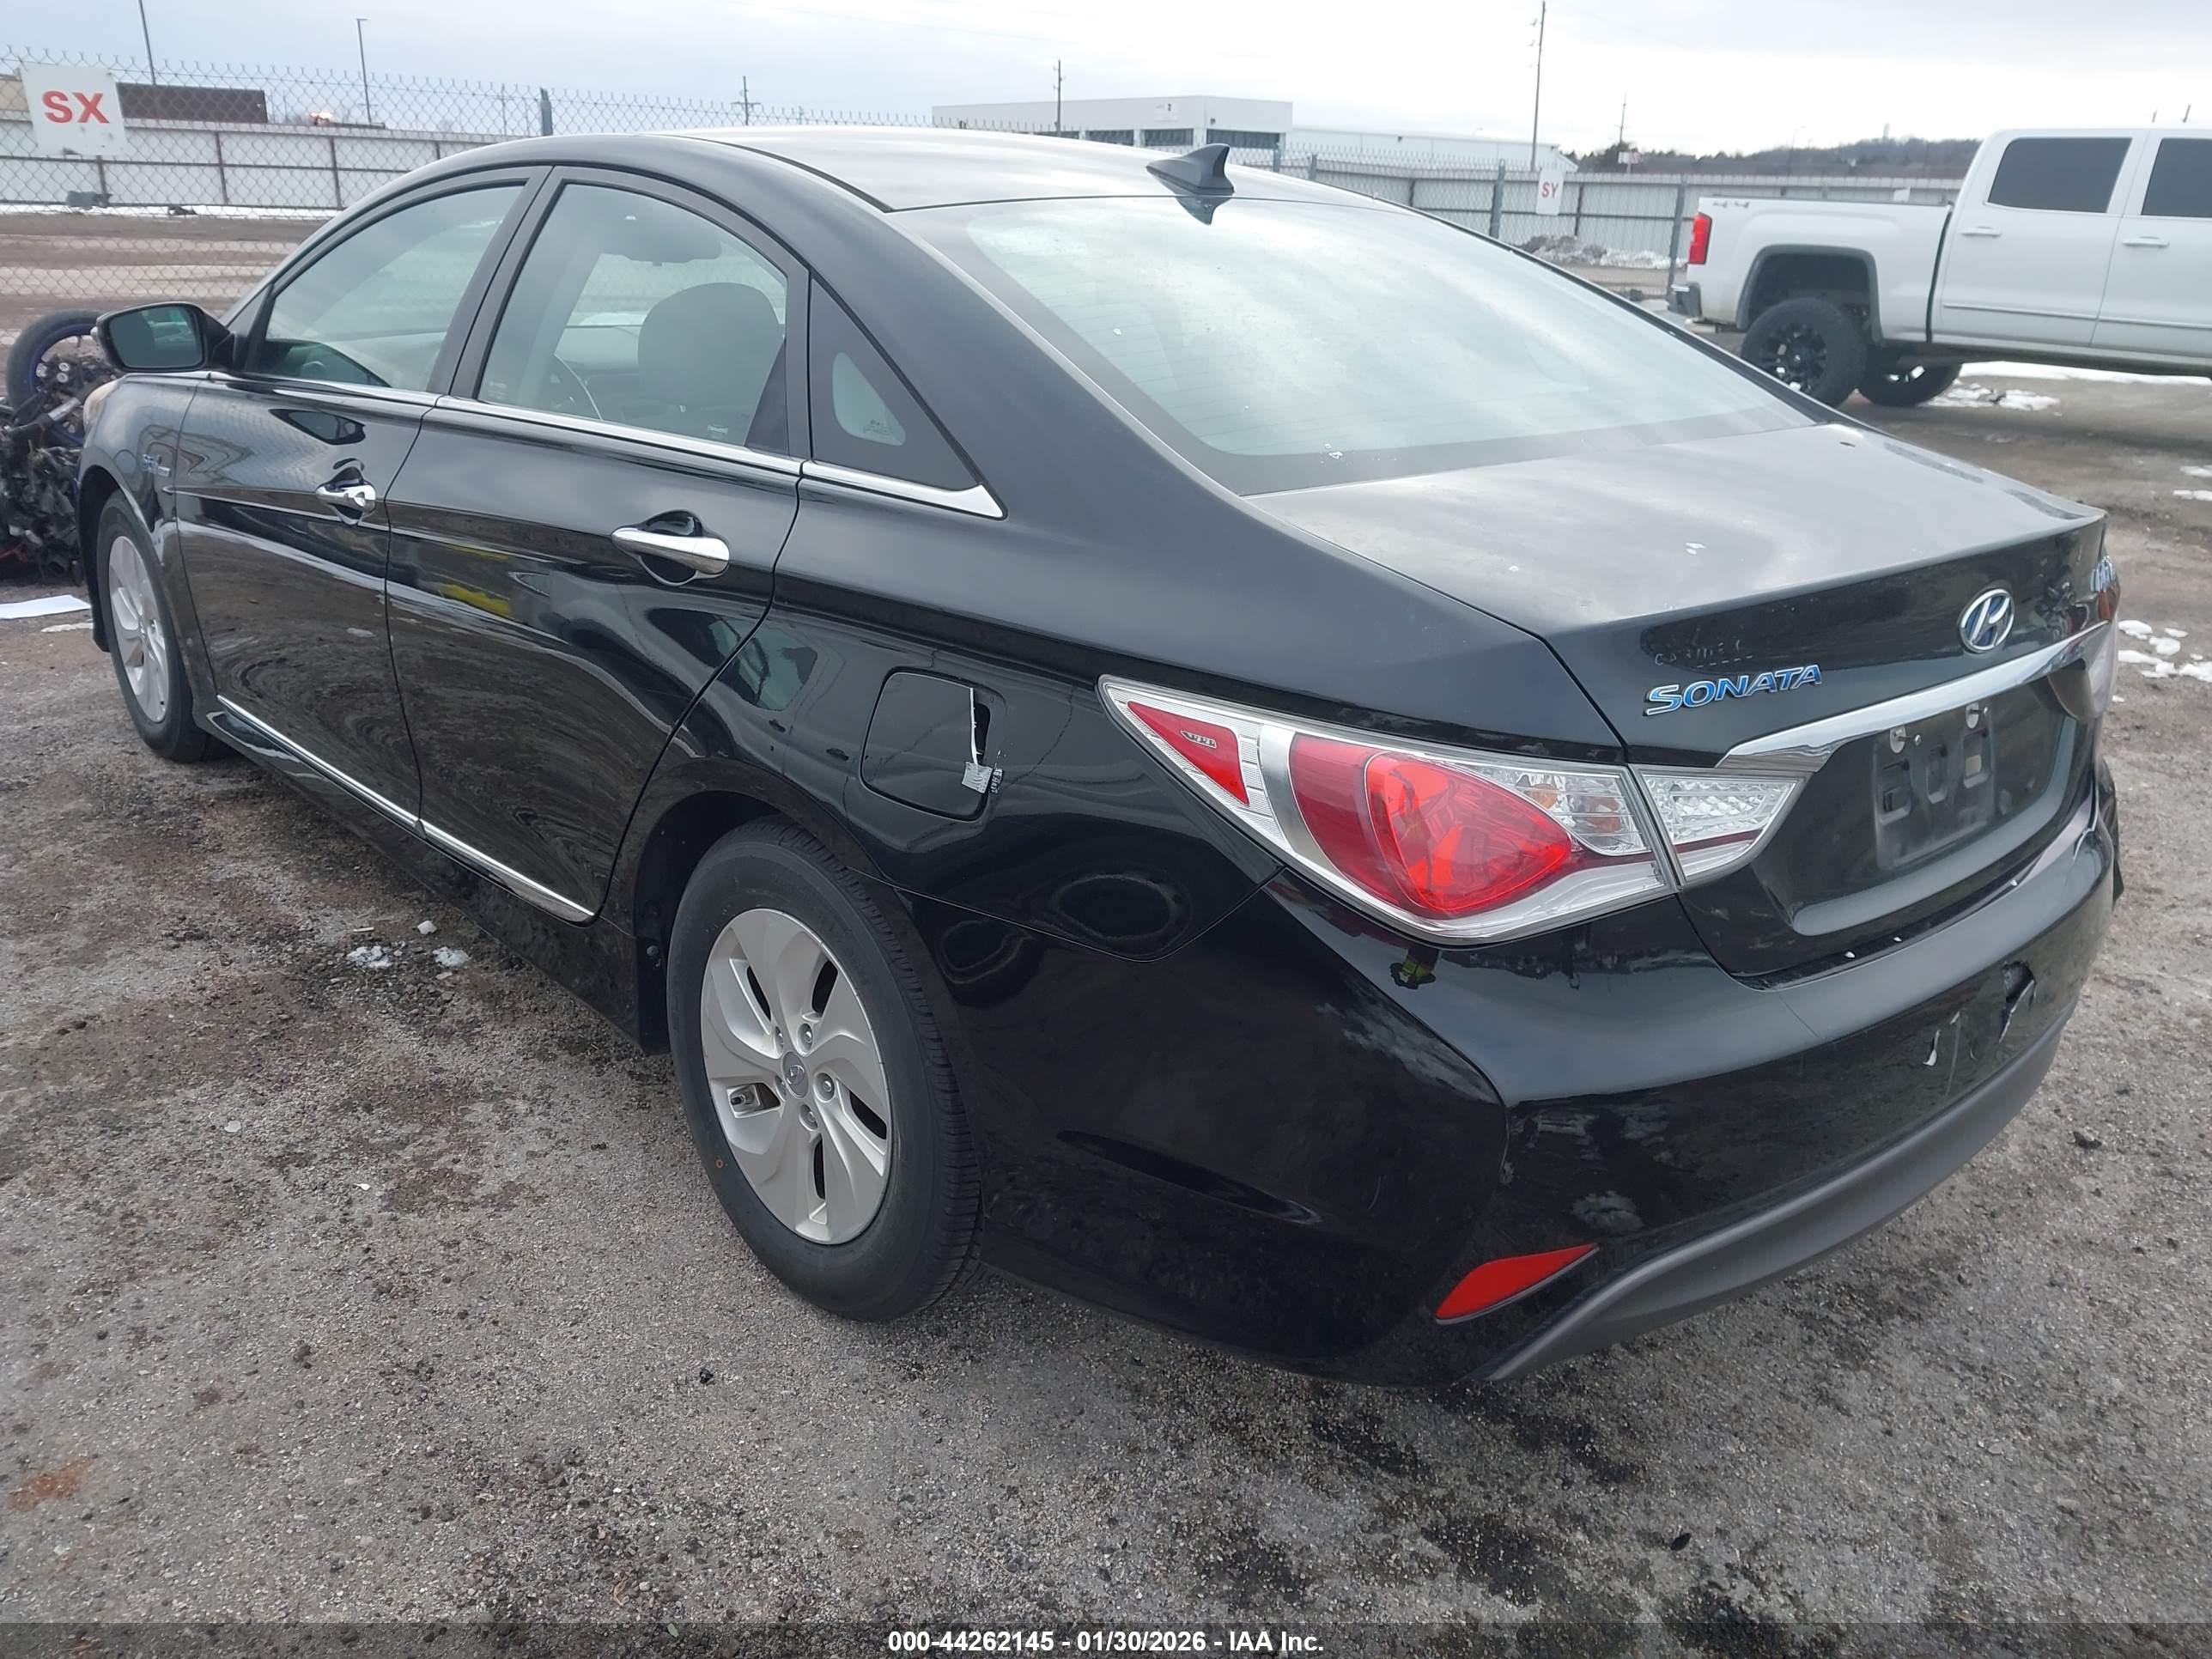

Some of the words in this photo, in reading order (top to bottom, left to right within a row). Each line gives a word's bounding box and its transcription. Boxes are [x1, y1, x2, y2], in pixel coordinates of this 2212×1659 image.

[41, 90, 110, 125] SX
[1541, 181, 1559, 198] SY
[1645, 664, 1823, 716] SONATA
